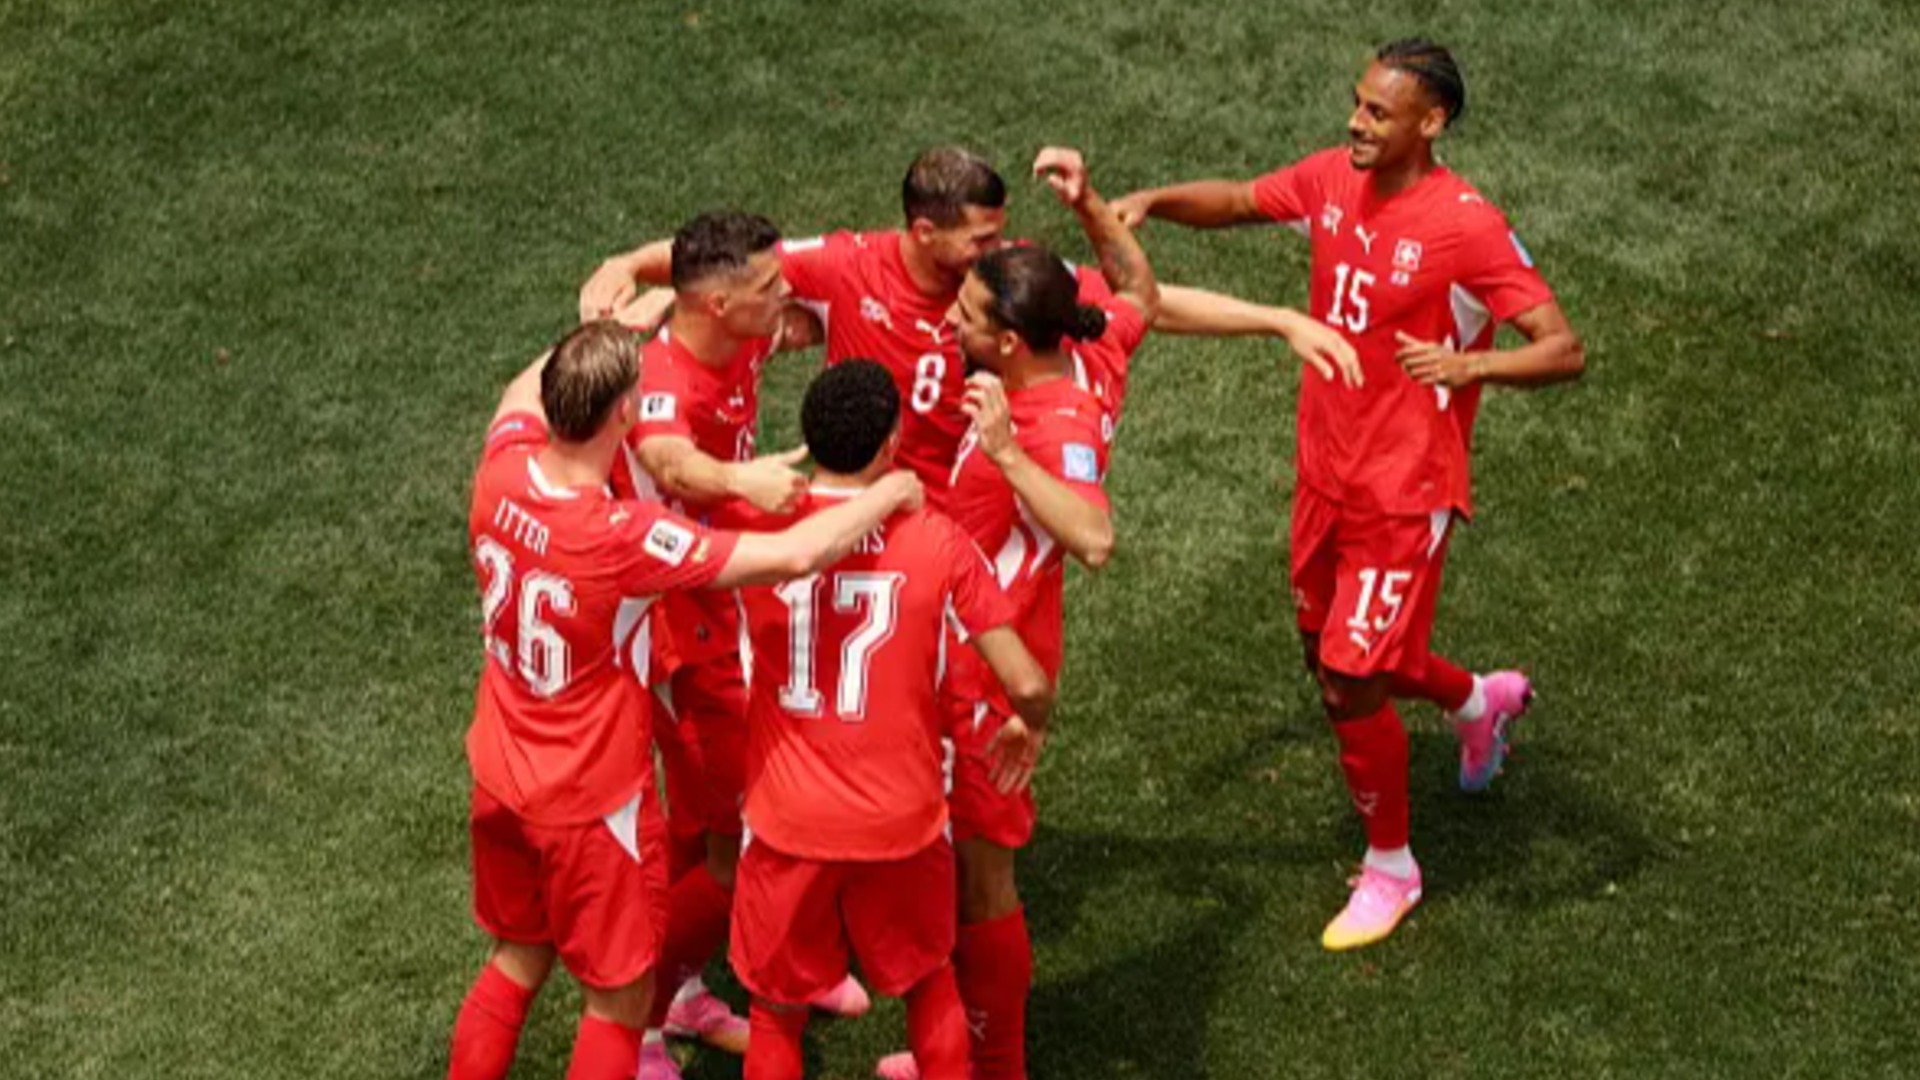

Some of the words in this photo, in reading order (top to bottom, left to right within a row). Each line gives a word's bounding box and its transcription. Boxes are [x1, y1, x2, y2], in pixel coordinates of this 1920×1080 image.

[1326, 262, 1376, 334] 15
[911, 353, 946, 412] 8
[475, 533, 577, 698] 26
[1346, 566, 1412, 632] 15
[773, 571, 906, 722] 17
